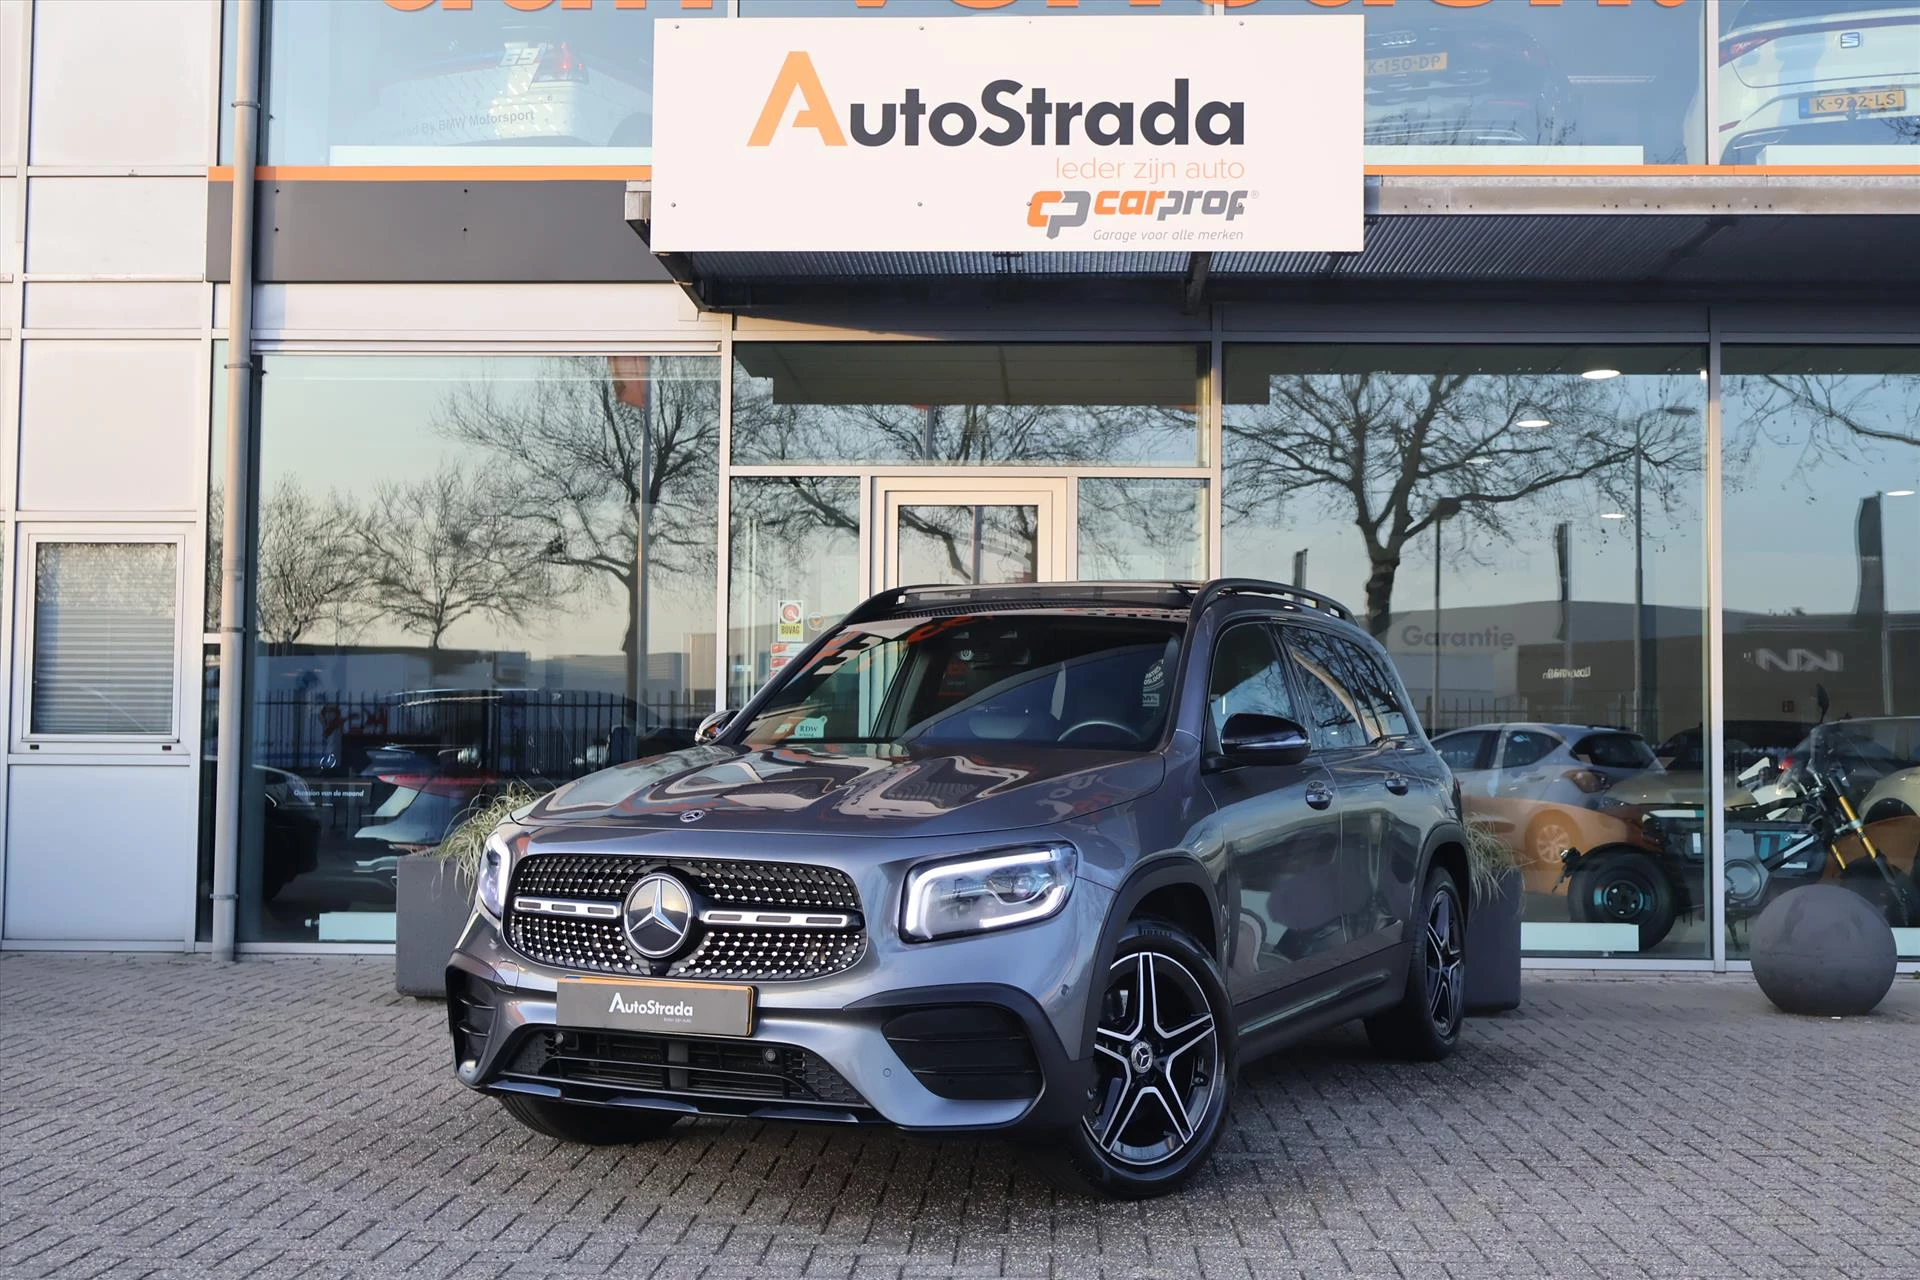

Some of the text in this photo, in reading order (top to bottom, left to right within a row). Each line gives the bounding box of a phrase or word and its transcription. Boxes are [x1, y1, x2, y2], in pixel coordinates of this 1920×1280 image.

[748, 51, 1245, 147] AutoStrada
[438, 117, 466, 131] BMW
[468, 110, 535, 129] Motorsport
[1056, 157, 1245, 185] Ieder zijn auto
[1093, 229, 1244, 243] Garage voor alle merken
[781, 625, 800, 635] BOVAG
[1401, 624, 1516, 650] Garantie
[333, 789, 342, 797] de
[342, 789, 365, 797] maand
[609, 992, 693, 1017] AutoStrada
